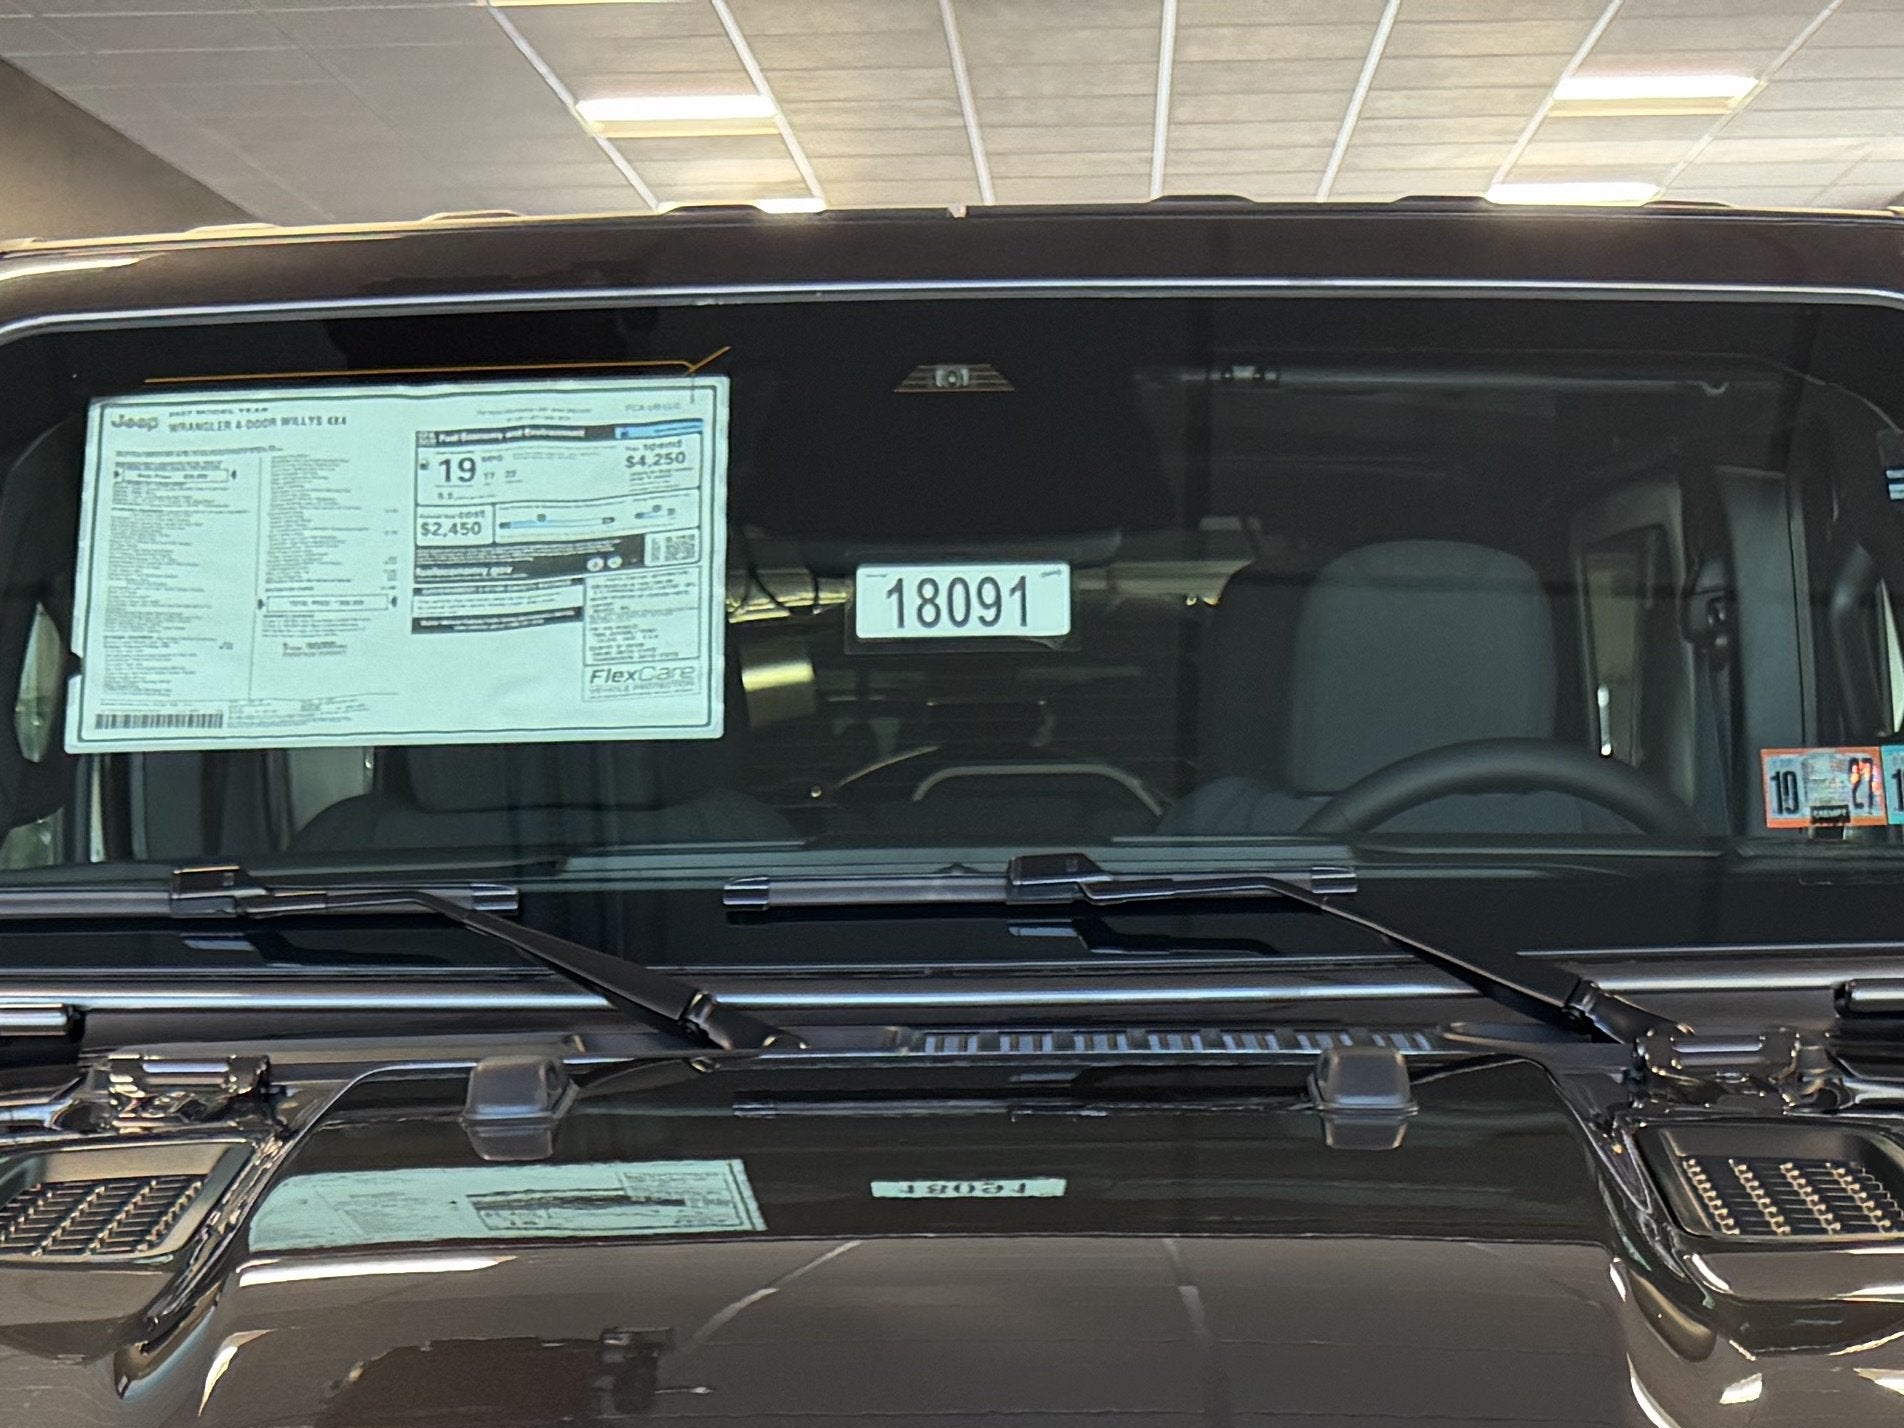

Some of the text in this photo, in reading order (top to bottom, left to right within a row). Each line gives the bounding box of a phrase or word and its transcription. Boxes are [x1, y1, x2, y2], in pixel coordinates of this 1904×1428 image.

[111, 414, 159, 432] Jeep
[169, 420, 232, 433] WRANGLER
[281, 417, 323, 428] WILLYS
[438, 457, 476, 483] 19
[420, 521, 482, 538] $2,450
[886, 575, 1028, 629] 18091
[589, 665, 697, 685] FlexCare
[1848, 757, 1874, 815] 27
